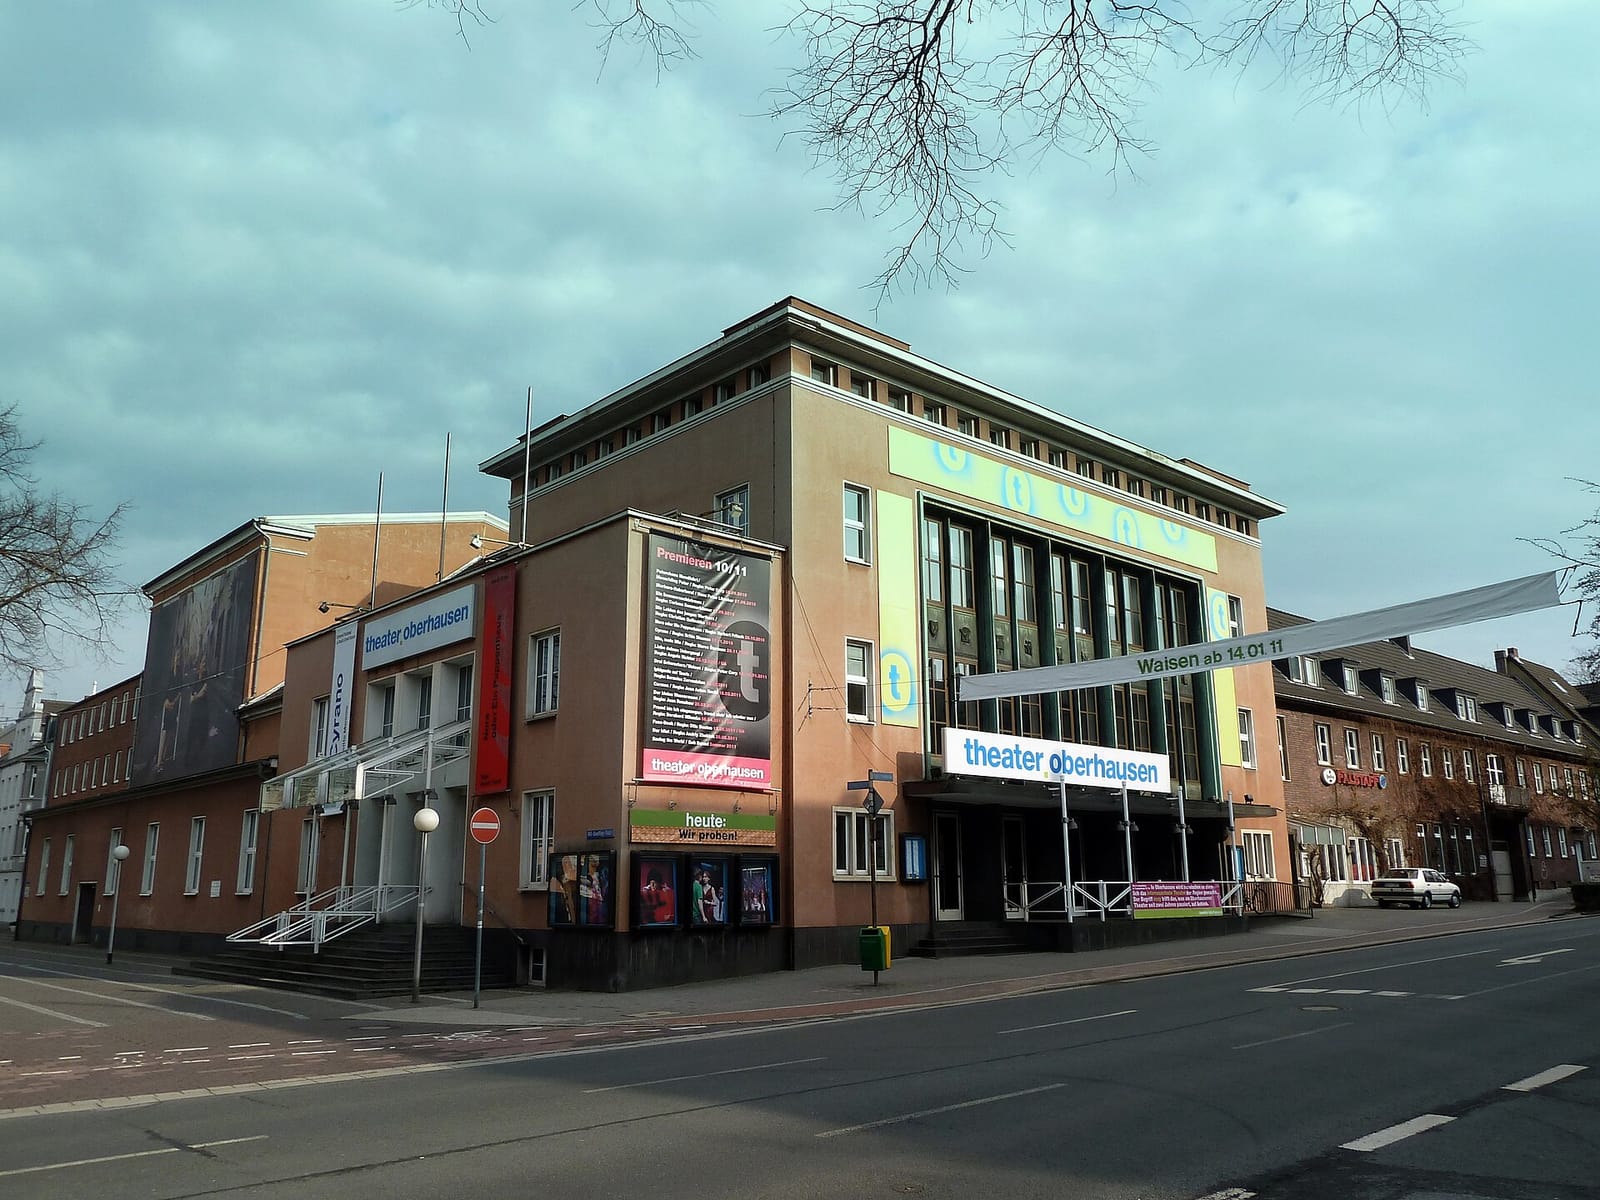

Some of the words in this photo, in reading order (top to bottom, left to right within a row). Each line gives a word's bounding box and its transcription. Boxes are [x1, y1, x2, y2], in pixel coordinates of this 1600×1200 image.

[656, 547, 713, 570] Premieren
[714, 561, 747, 577] 10/11
[365, 628, 401, 653] theater
[403, 605, 469, 640] oberhausen
[1137, 652, 1199, 674] Waisen
[1204, 650, 1222, 666] ab
[651, 758, 694, 774] theater
[697, 764, 764, 779] oberhausen
[964, 737, 1045, 773] theater
[1049, 752, 1158, 784] oberhausen
[686, 812, 726, 828] heute:
[679, 829, 696, 839] Wir
[700, 831, 738, 840] proben!
